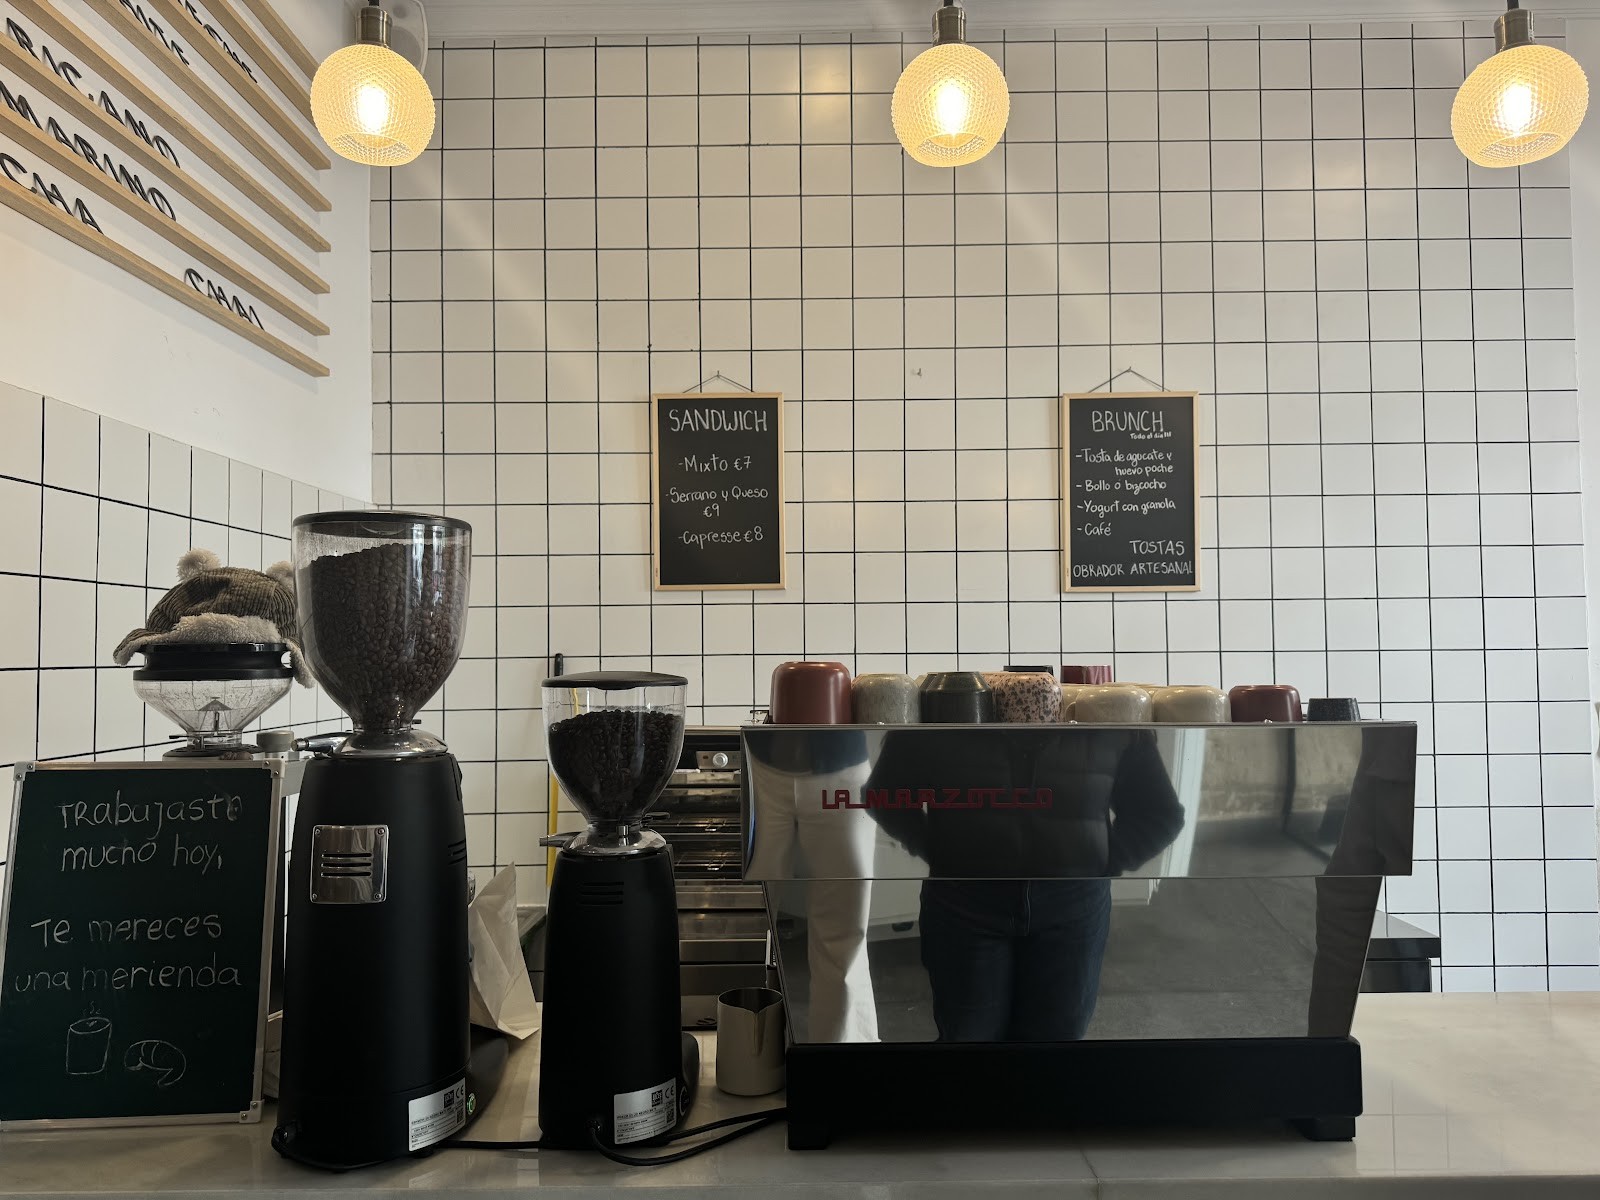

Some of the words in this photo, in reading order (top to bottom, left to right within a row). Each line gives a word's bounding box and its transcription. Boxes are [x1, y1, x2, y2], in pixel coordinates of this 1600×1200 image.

[178, 0, 258, 83] ECHE
[669, 408, 768, 432] SANDWICH
[1091, 410, 1164, 432] BRUNCH
[1113, 450, 1125, 462] de
[1115, 466, 1143, 476] huevo
[721, 491, 729, 501] y
[731, 485, 769, 500] Queso
[1125, 478, 1167, 495] bizcocho
[703, 503, 720, 518] €9
[1122, 504, 1139, 512] con
[1141, 498, 1177, 515] granola
[1129, 539, 1185, 556] TOSTAS
[1072, 563, 1126, 578] OBRADOR
[1130, 560, 1193, 575] ARTESANAL
[821, 789, 850, 810] LA
[61, 841, 157, 872] mucho
[31, 918, 73, 948] Te
[88, 914, 223, 944] mereces
[15, 970, 72, 993] una
[81, 952, 243, 991] merienda
